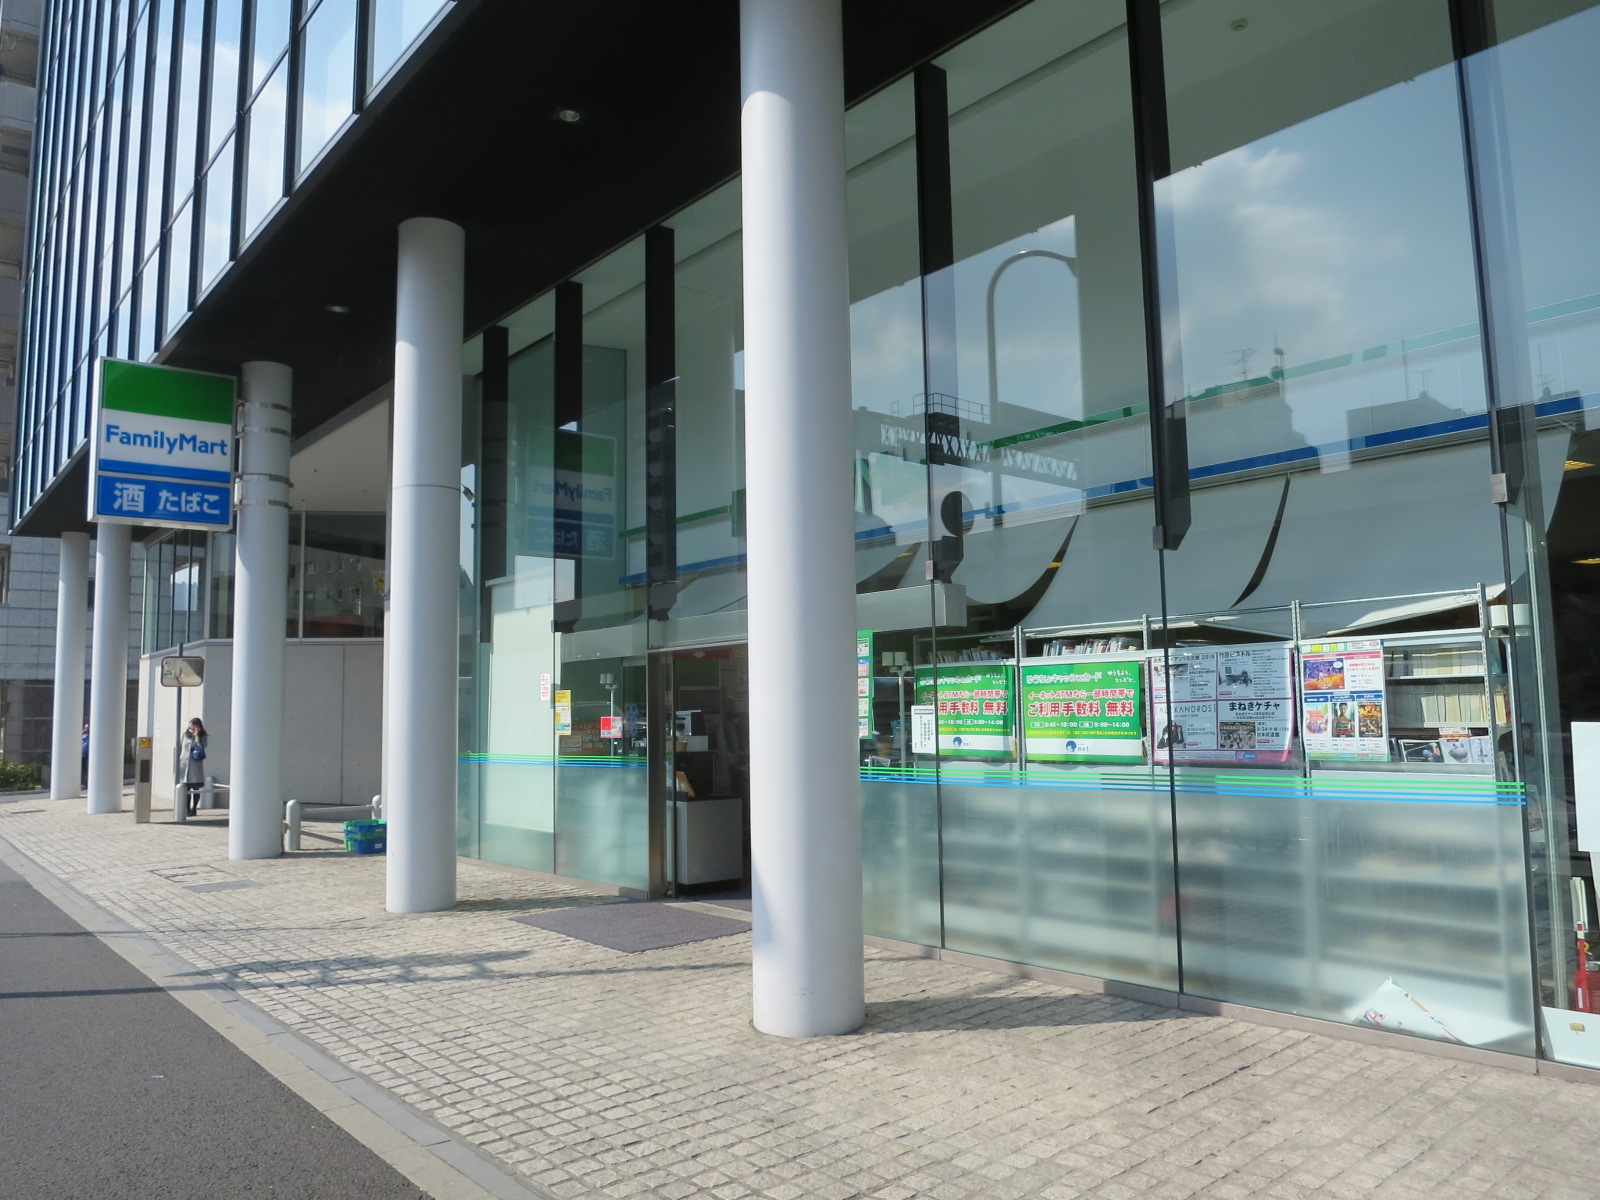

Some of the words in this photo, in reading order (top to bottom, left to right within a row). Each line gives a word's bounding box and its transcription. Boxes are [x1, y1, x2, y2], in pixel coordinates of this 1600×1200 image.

[106, 424, 228, 456] FamilyMart
[113, 482, 146, 512] 酒
[158, 489, 220, 515] たばこ
[1028, 688, 1135, 700] イーネットATMなら一部時間帯で
[983, 700, 1008, 716] 無料
[1028, 701, 1101, 717] ご利用手数料
[1105, 700, 1135, 717] 無料
[1229, 701, 1280, 712] まねきケチャ
